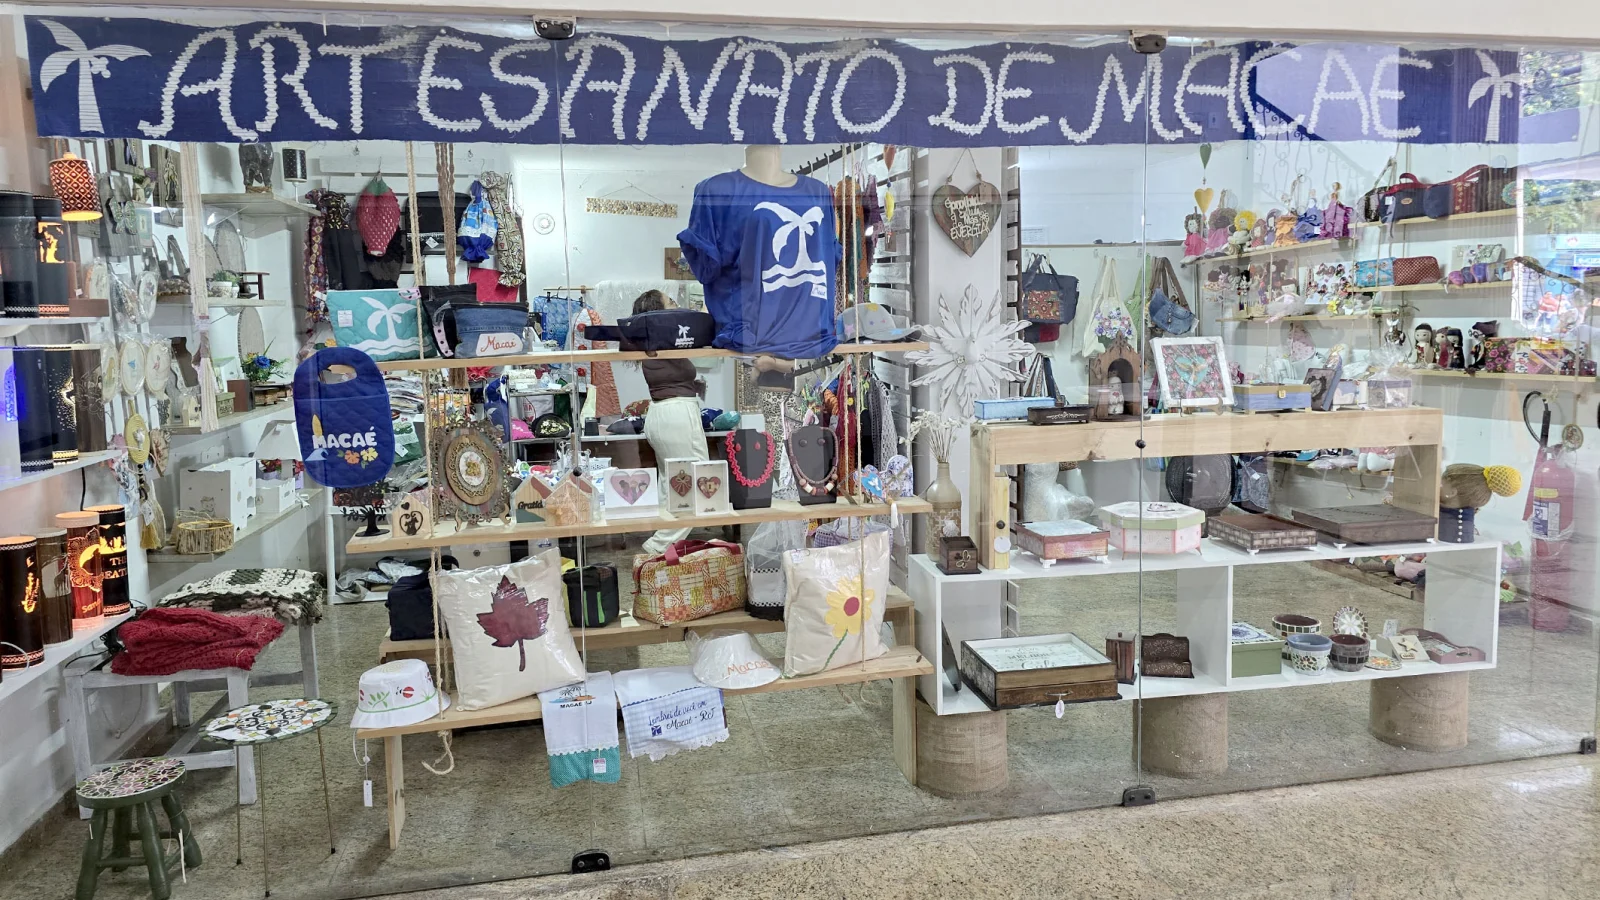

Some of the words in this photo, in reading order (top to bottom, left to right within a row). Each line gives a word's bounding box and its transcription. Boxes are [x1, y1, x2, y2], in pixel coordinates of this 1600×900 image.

[137, 26, 906, 143] ARTESANATO
[928, 51, 1055, 136] DE
[312, 425, 377, 449] MACAÉ
[673, 705, 682, 717] de
[699, 707, 716, 722] RJ
